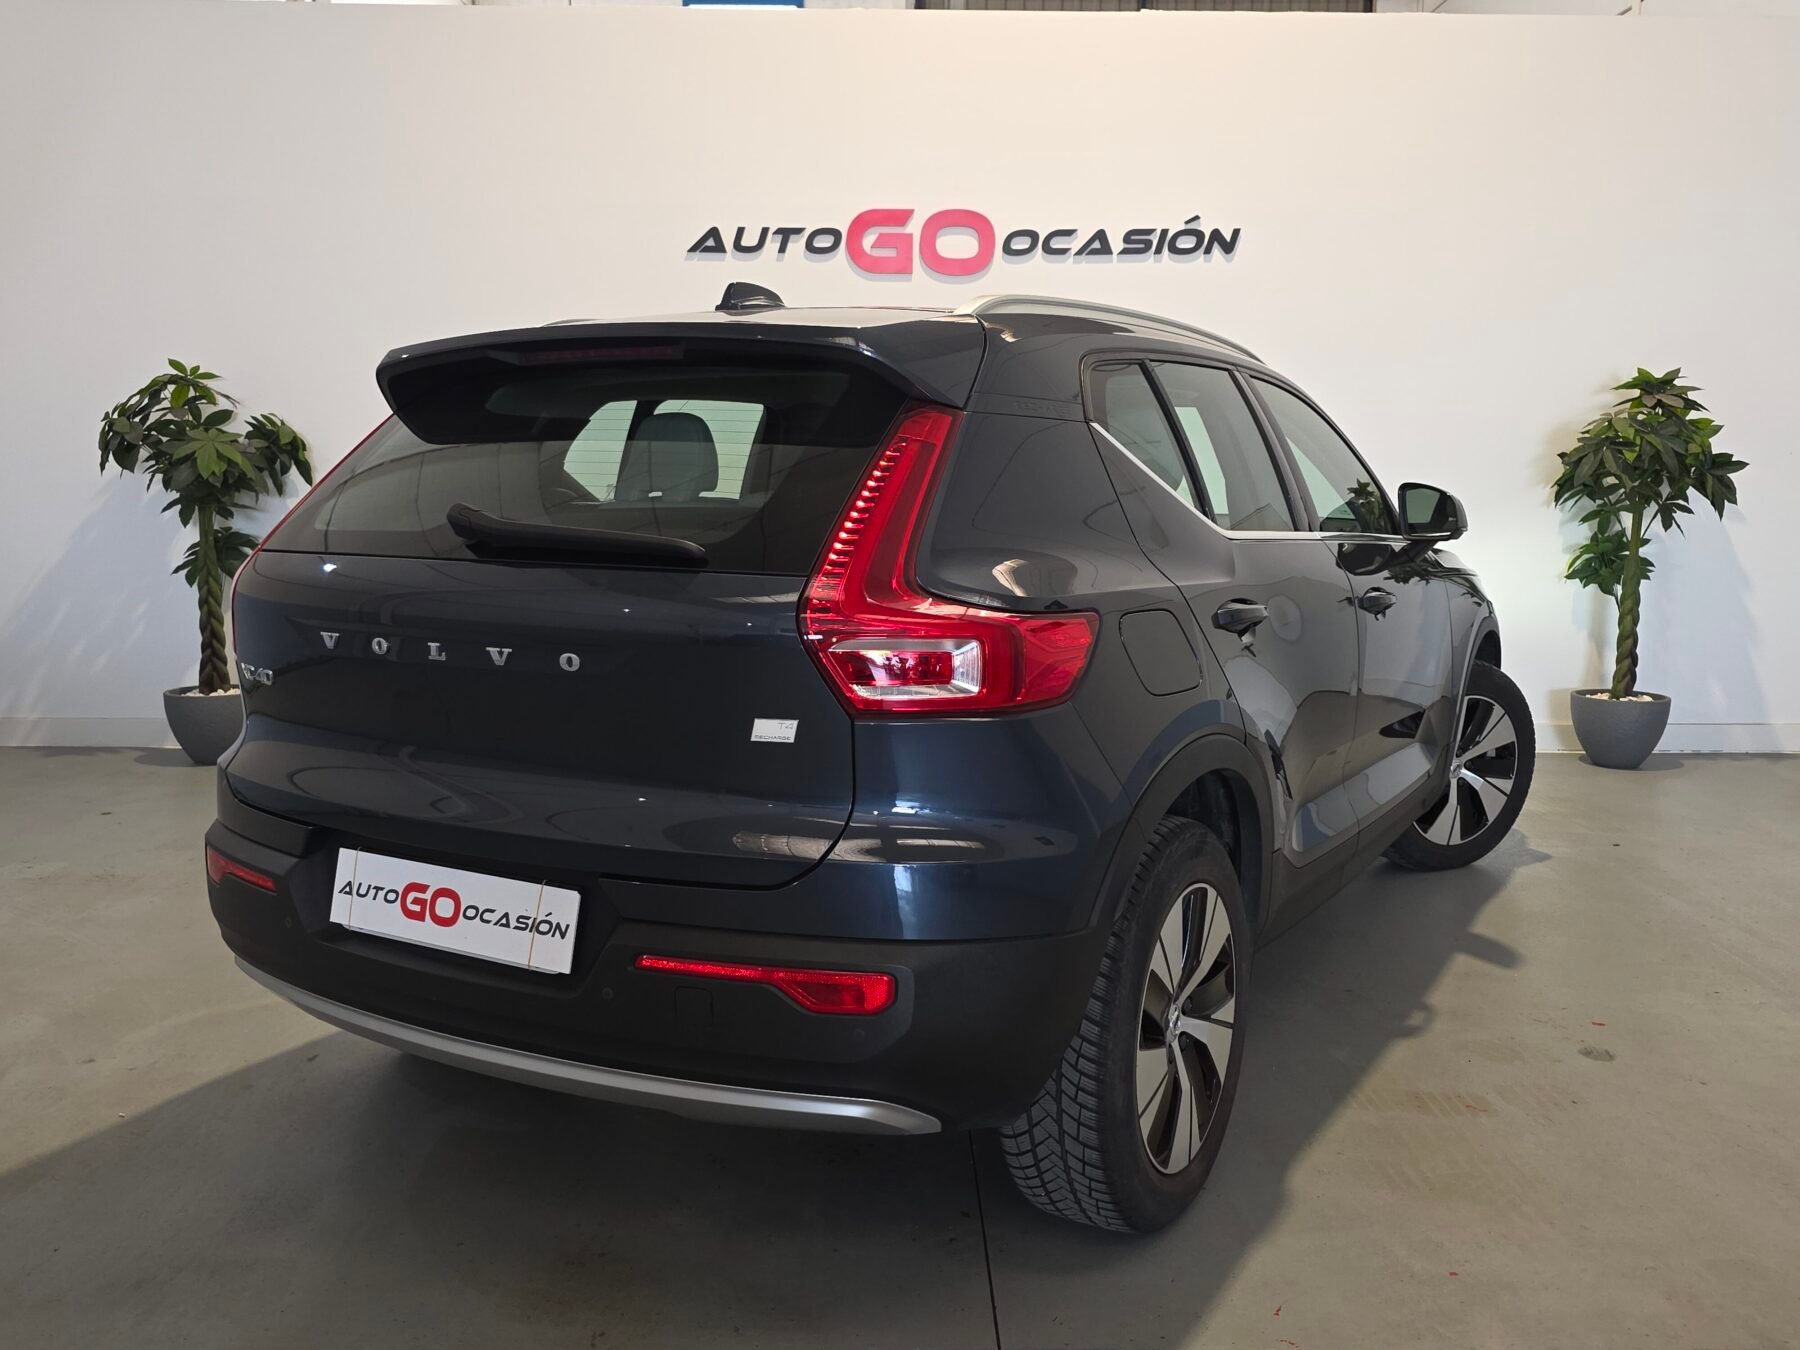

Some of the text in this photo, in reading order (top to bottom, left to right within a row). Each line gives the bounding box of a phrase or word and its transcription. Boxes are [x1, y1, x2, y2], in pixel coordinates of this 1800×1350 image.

[687, 209, 1241, 276] AUTO GO OCASIÓN
[320, 631, 580, 672] VOLVO
[338, 880, 570, 940] AUTO GO OCASIÓN
